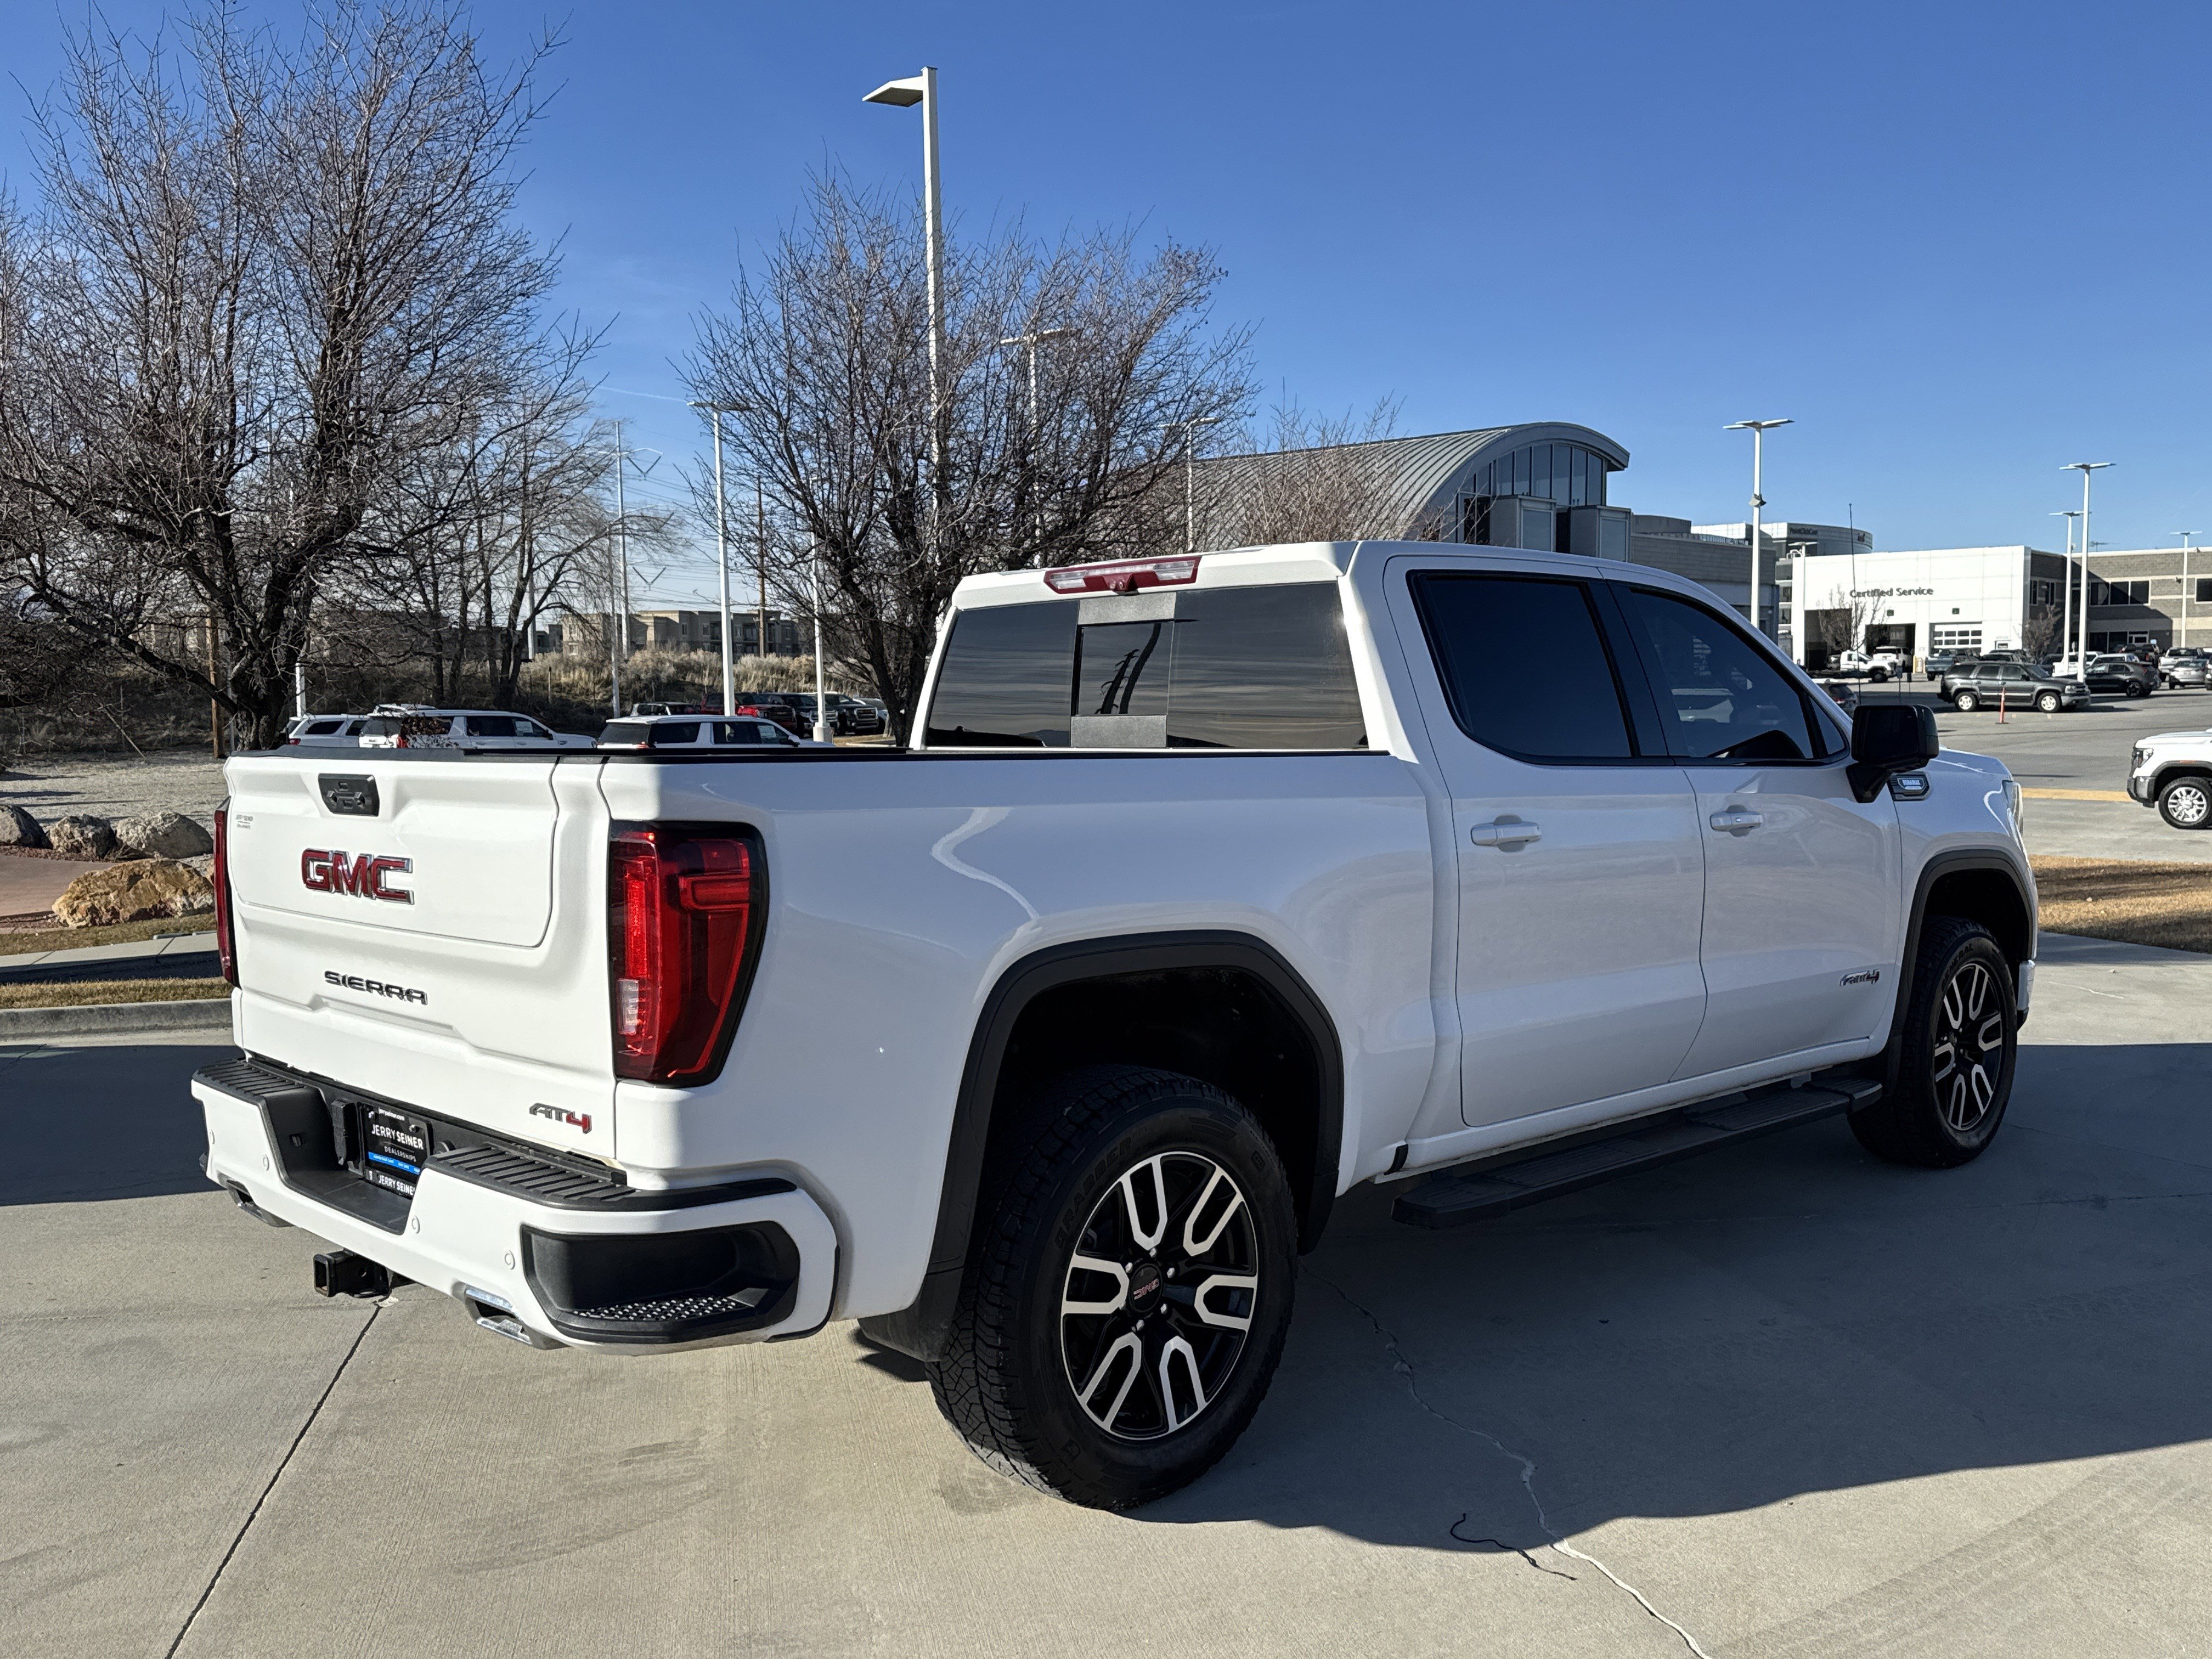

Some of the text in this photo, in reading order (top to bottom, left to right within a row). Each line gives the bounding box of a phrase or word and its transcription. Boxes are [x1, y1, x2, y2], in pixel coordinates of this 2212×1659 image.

[1849, 586, 1934, 597] Certified Service
[301, 848, 415, 905] GMC
[324, 970, 428, 1005] SIERRA
[529, 1102, 592, 1134] AT4
[371, 1124, 424, 1150] JERRY SEINER
[377, 1175, 396, 1189] JERRY
[1133, 1278, 1160, 1300] GMC
